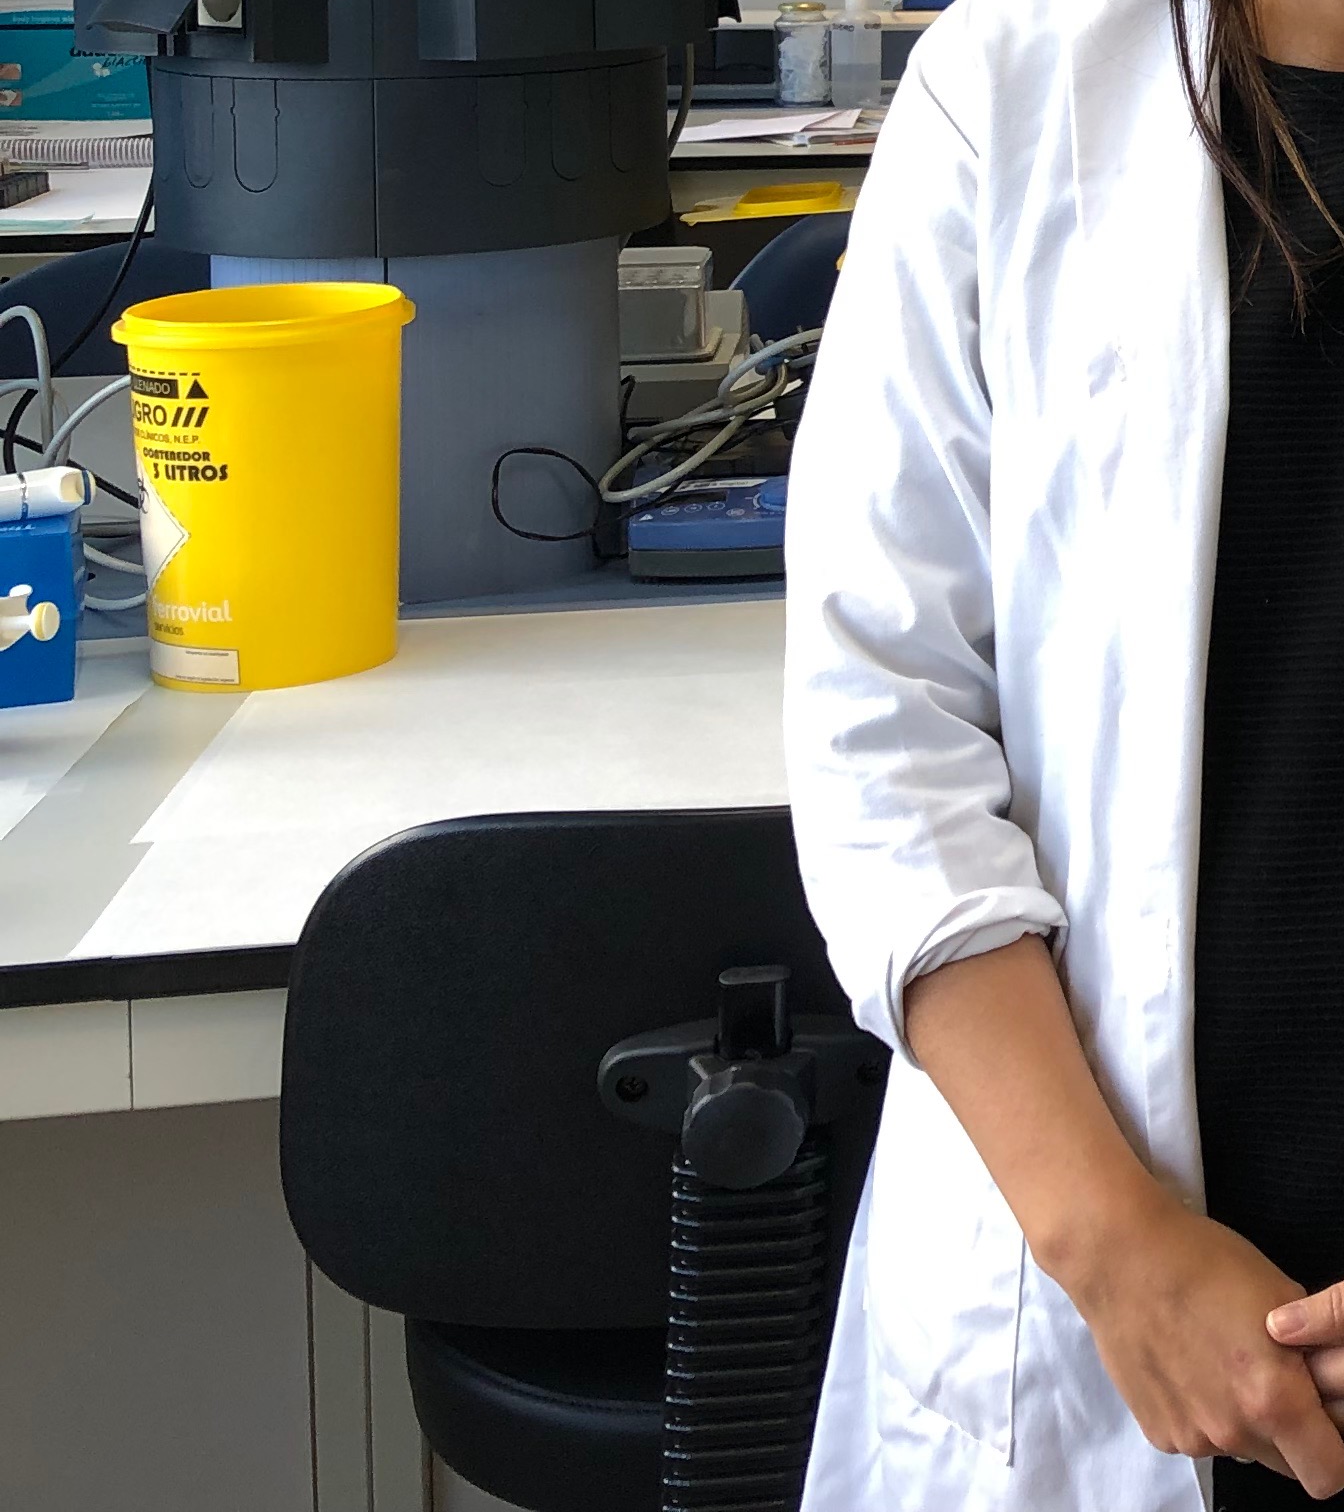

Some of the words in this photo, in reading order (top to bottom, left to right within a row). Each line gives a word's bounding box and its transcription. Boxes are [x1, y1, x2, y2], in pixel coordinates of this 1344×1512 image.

[133, 379, 171, 395] LENADO
[143, 447, 211, 462] CONTENEDOR
[164, 464, 229, 482] LITROS
